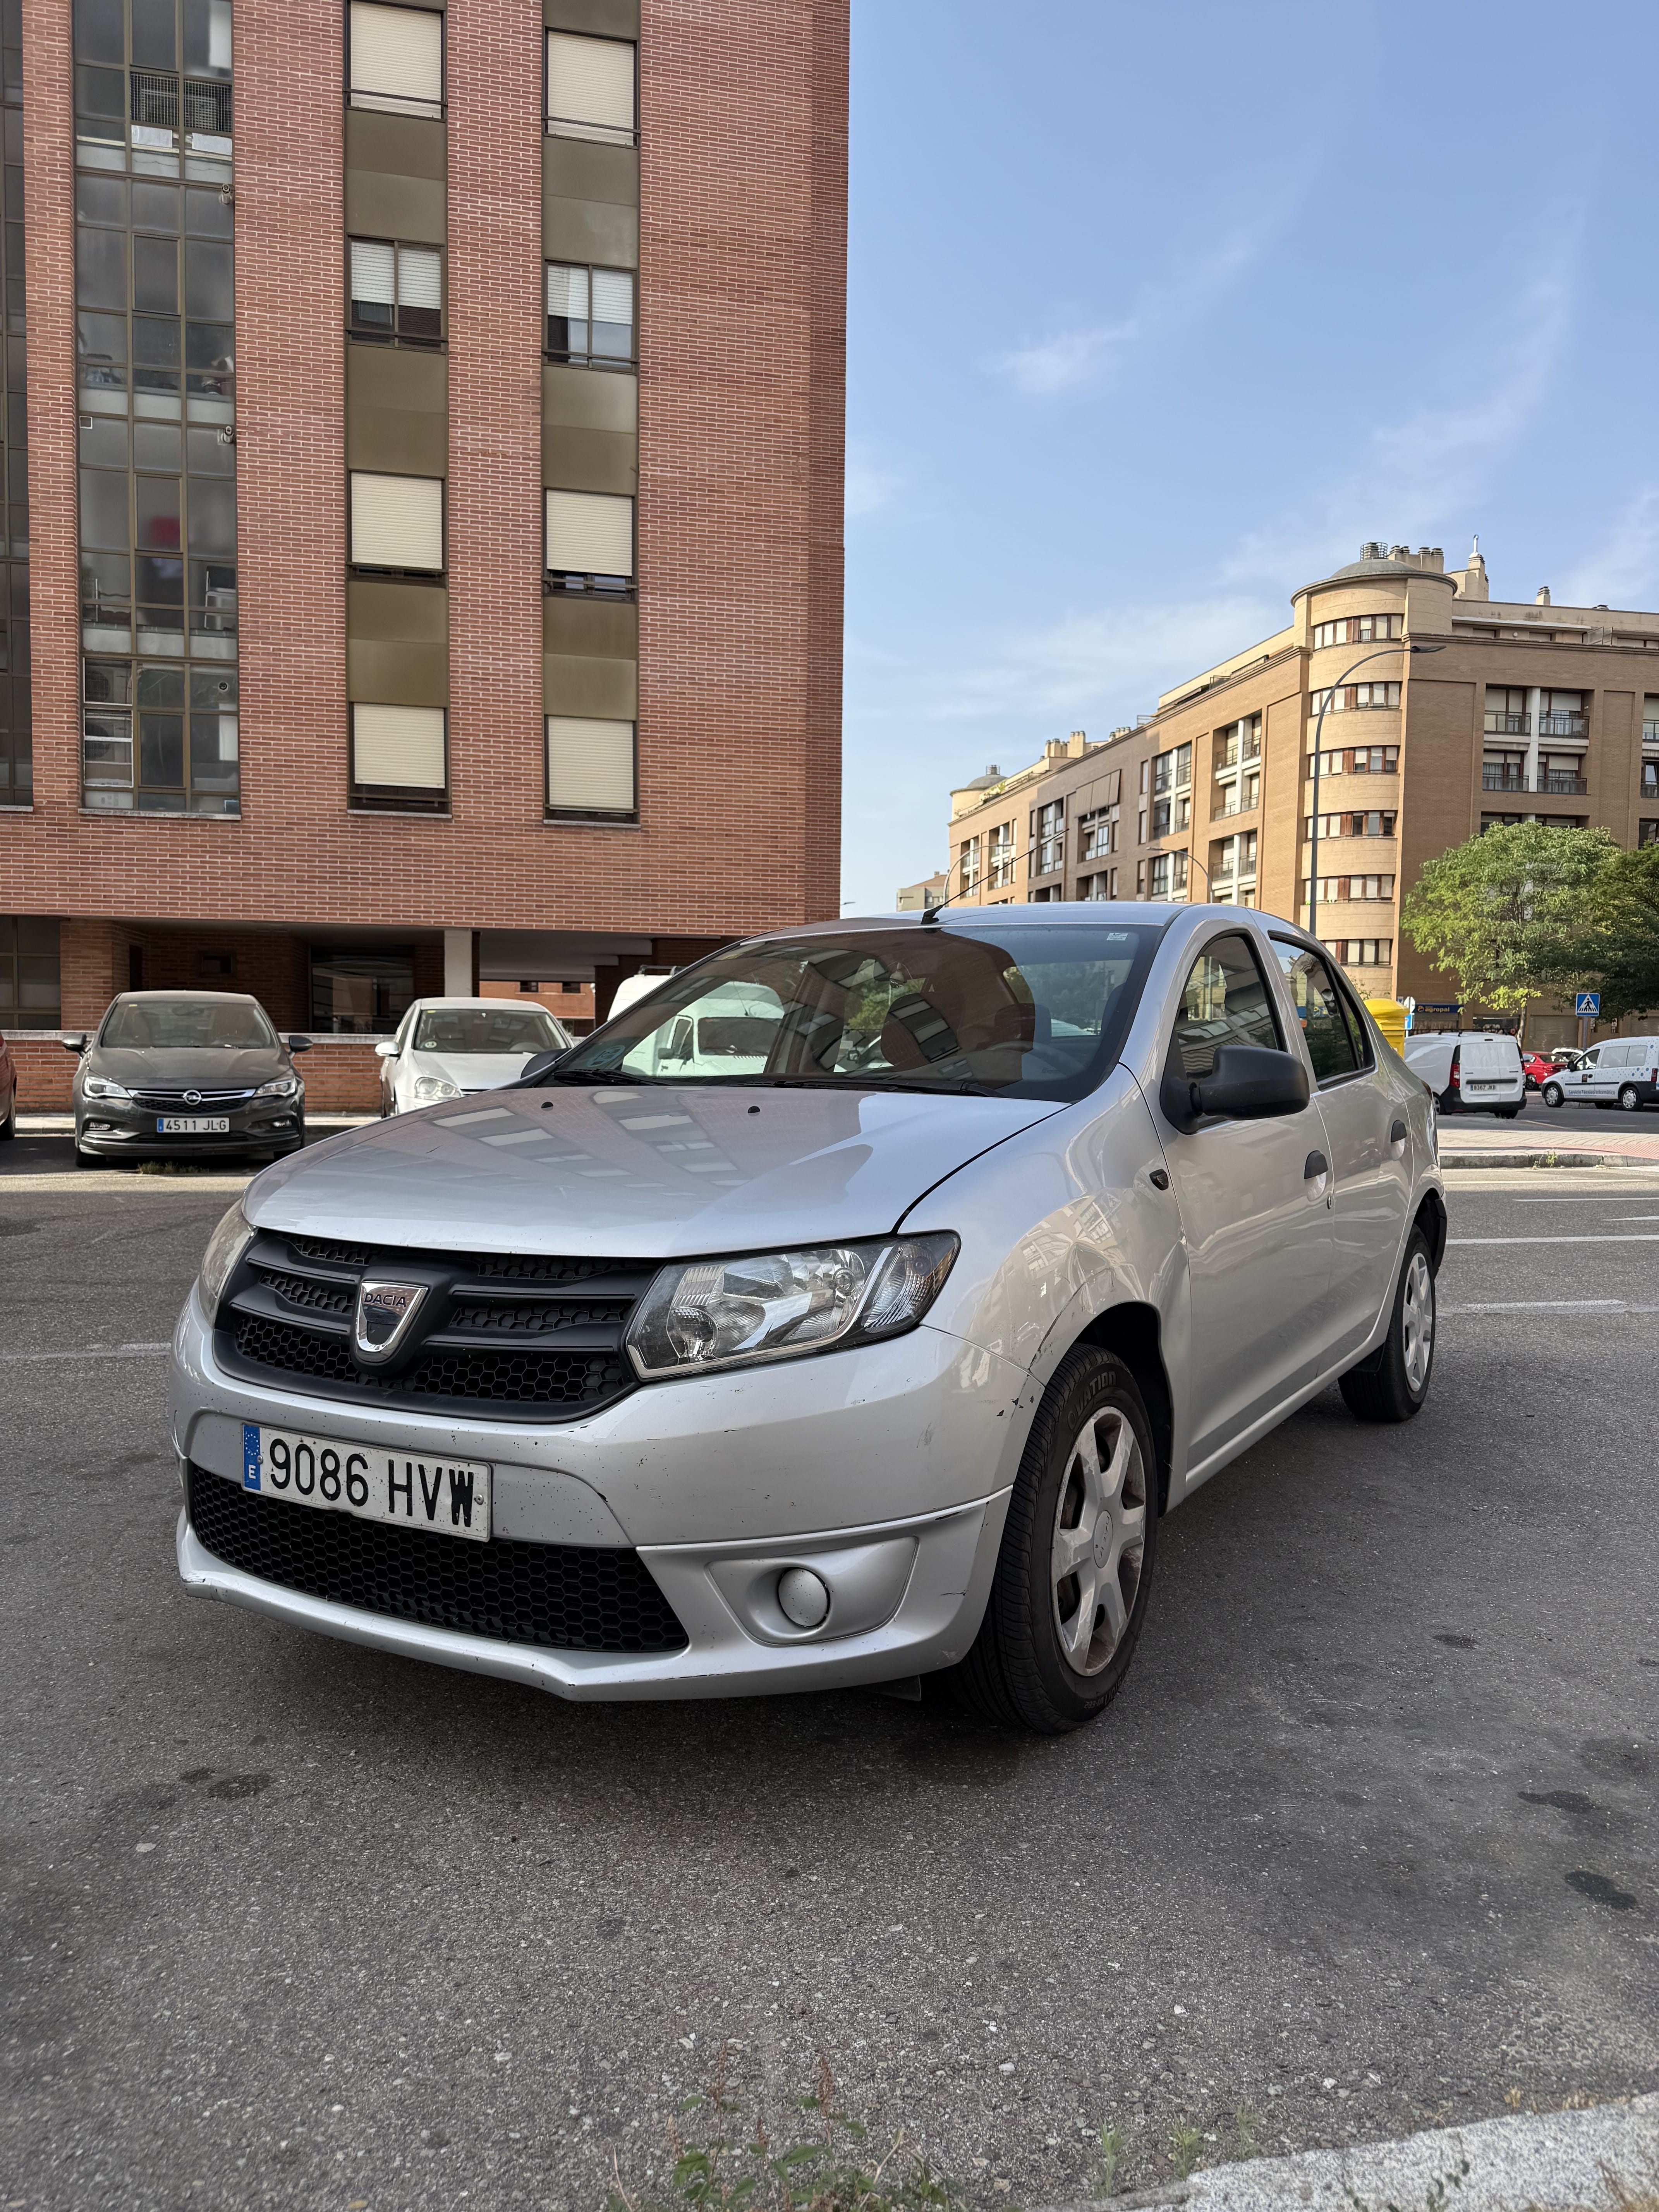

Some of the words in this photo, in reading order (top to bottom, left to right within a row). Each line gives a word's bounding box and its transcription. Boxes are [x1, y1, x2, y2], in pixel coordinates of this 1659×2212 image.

[166, 1120, 196, 1130] 4511
[203, 1120, 226, 1130] JLG
[364, 1293, 406, 1307] DACIA
[248, 1465, 256, 1479] E
[269, 1438, 369, 1507] 9086
[388, 1459, 474, 1528] HVW
